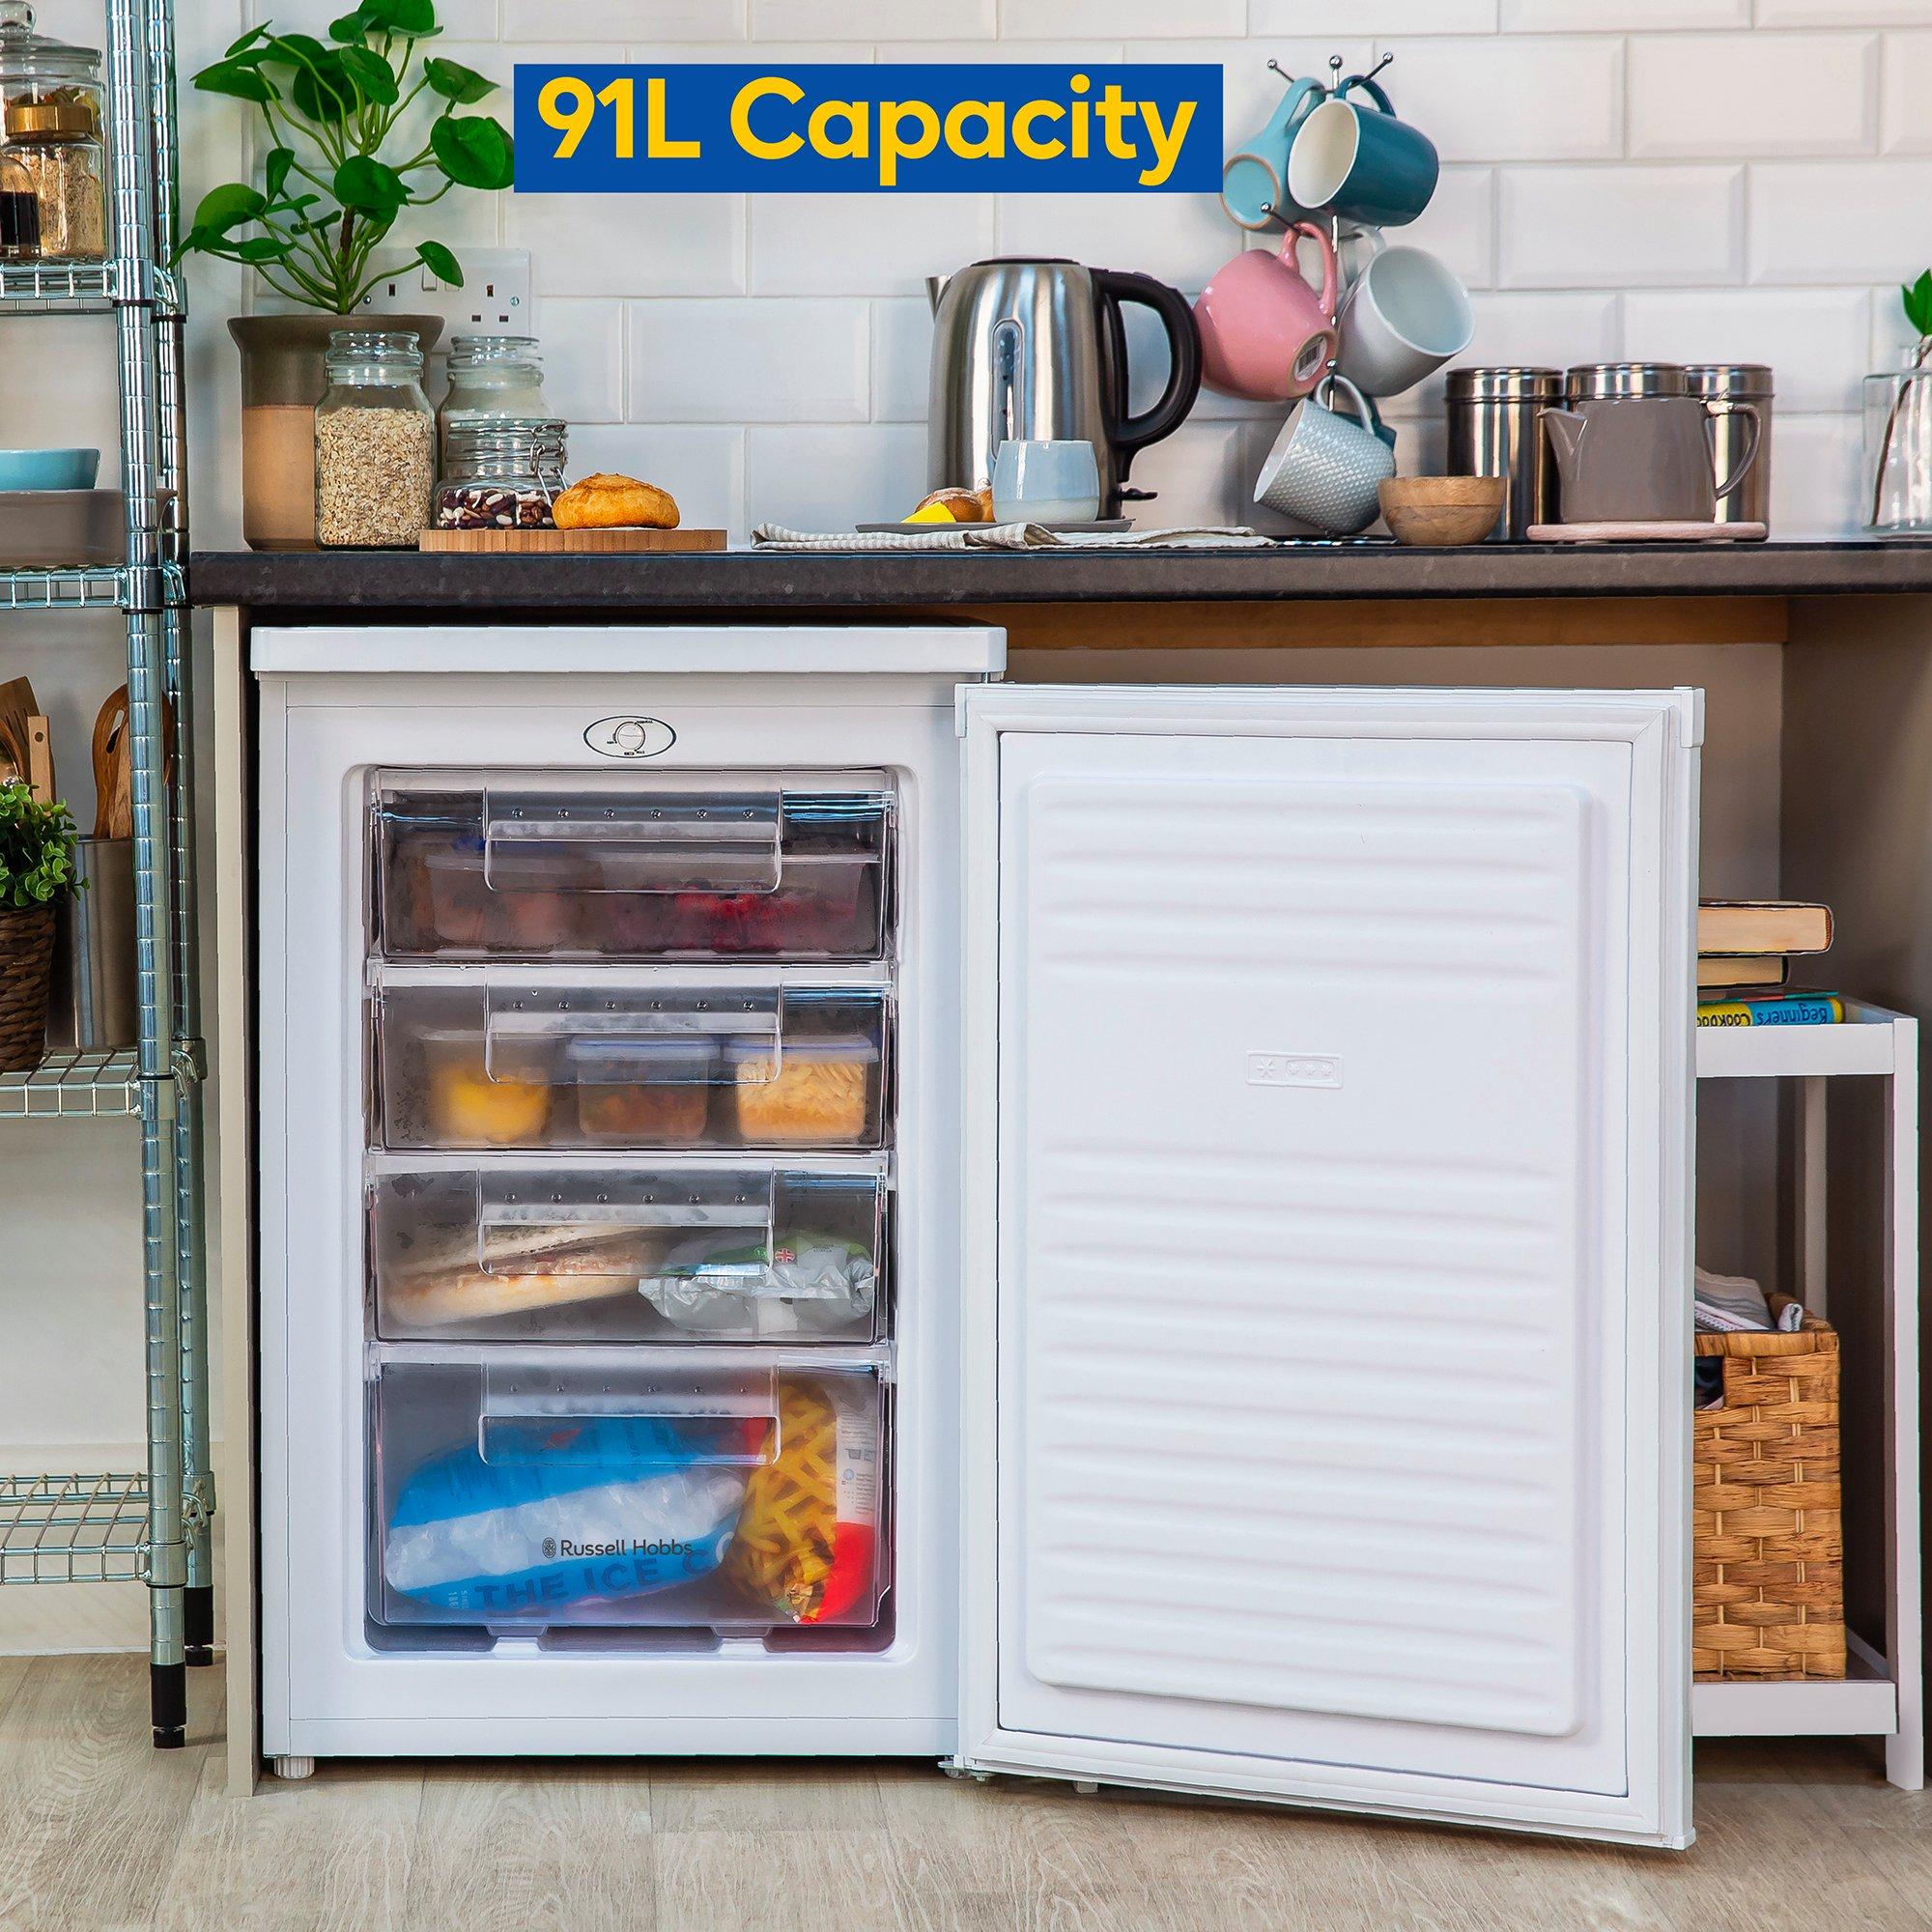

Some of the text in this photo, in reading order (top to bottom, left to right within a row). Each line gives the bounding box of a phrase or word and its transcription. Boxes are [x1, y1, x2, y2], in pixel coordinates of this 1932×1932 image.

[560, 1538, 694, 1556] Russell Hobbs
[474, 1573, 568, 1608] THE
[583, 1557, 660, 1592] ICE
